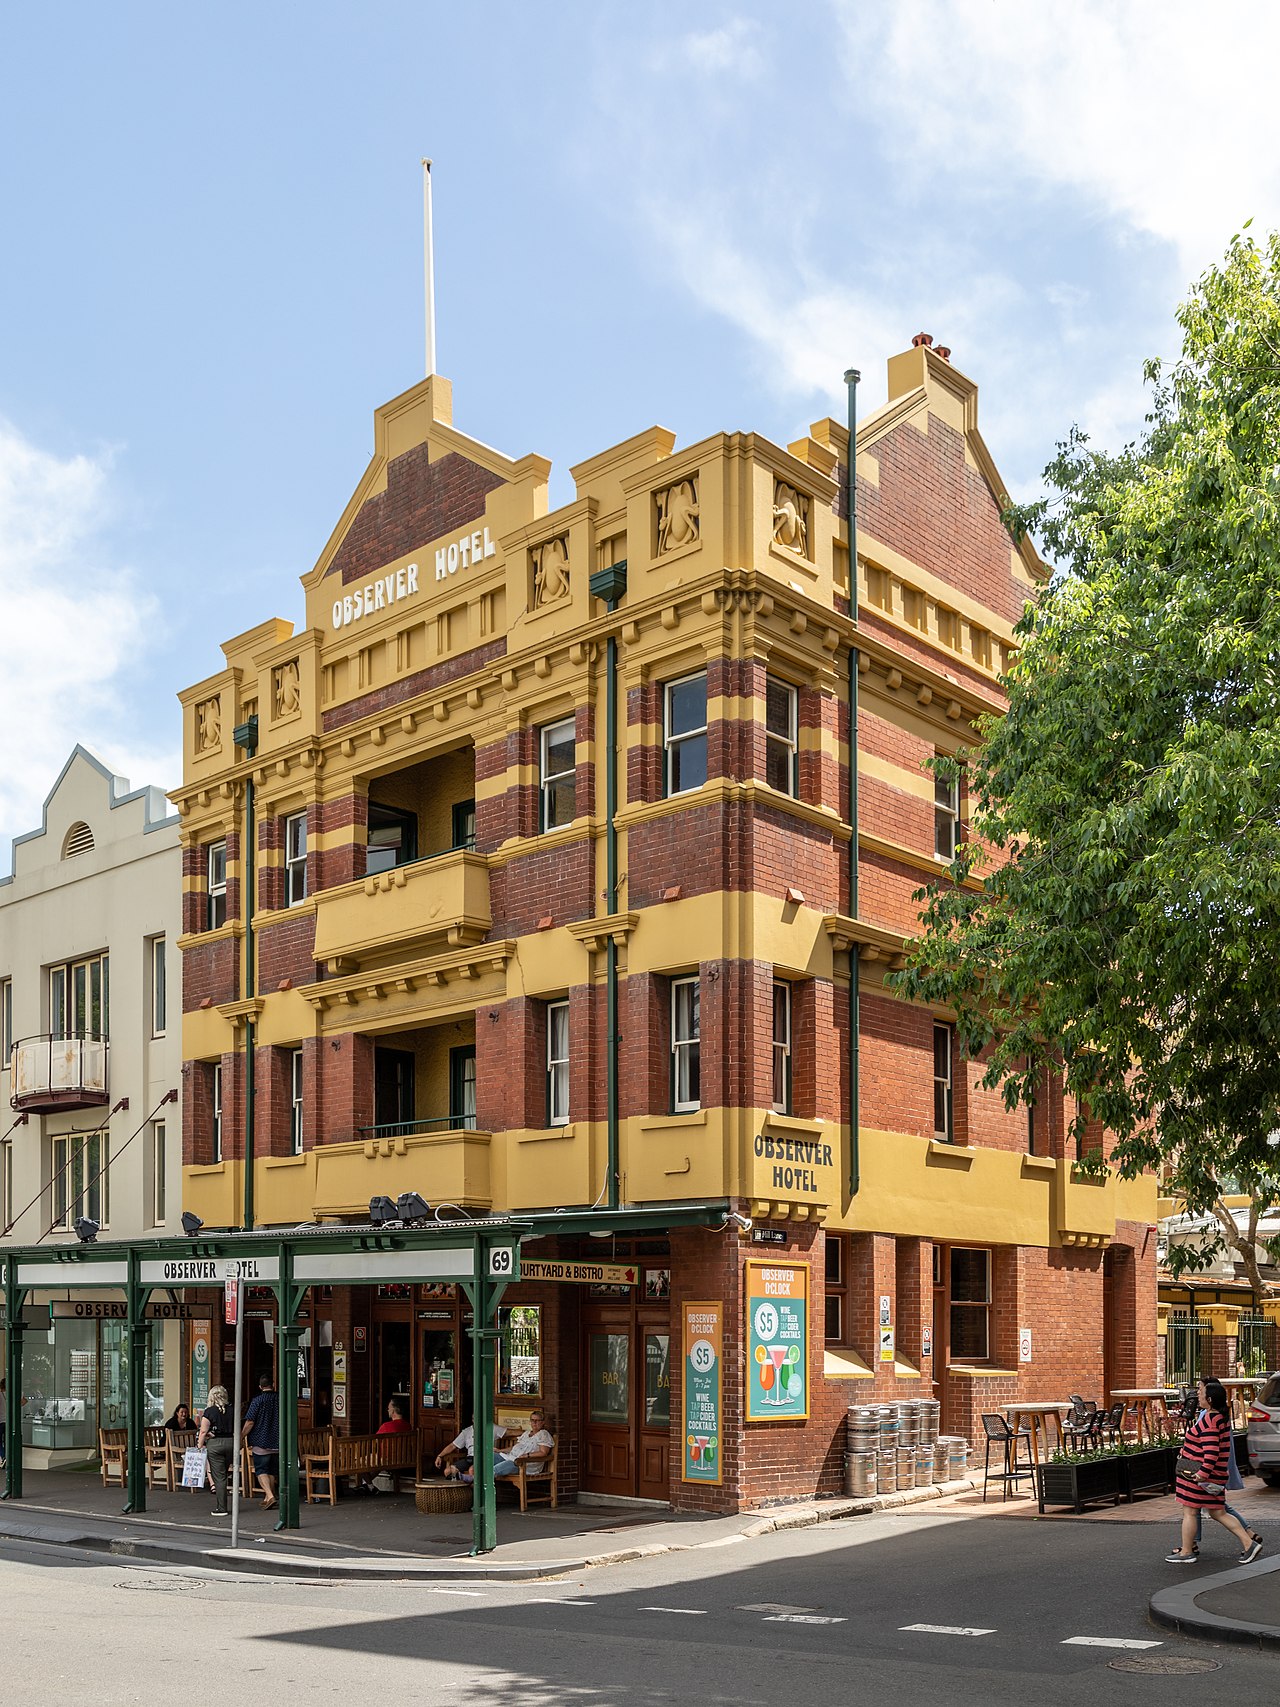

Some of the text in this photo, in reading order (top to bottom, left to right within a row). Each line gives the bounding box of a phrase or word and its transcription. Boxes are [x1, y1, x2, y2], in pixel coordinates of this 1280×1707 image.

[332, 527, 496, 630] OBSERVER HOTEL
[754, 1135, 833, 1166] OBSERVER
[773, 1166, 817, 1192] HOTEL
[492, 1251, 510, 1271] 69
[164, 1262, 217, 1279] OBSERVER
[236, 1261, 259, 1278] OTEL
[566, 1267, 572, 1279] &
[574, 1267, 603, 1280] BISTRO
[762, 1268, 794, 1282] OBSERVER
[765, 1282, 791, 1295] O'CLOCK
[75, 1303, 193, 1318] OBSERV HOTEL
[780, 1306, 791, 1314] WINE
[688, 1313, 718, 1324] OBSERVER
[760, 1311, 773, 1333] $5
[691, 1323, 714, 1334] O'CLOCK
[780, 1331, 801, 1339] COCKTAILS
[197, 1344, 205, 1358] $5
[334, 1341, 343, 1350] 69
[696, 1347, 710, 1366] $5
[602, 1371, 619, 1385] BAR
[657, 1374, 670, 1388] BA
[695, 1393, 710, 1402] WINE
[691, 1402, 715, 1412] TAP BEER
[690, 1411, 716, 1421] TAP CIDER
[688, 1420, 717, 1431] COCKTAILS
